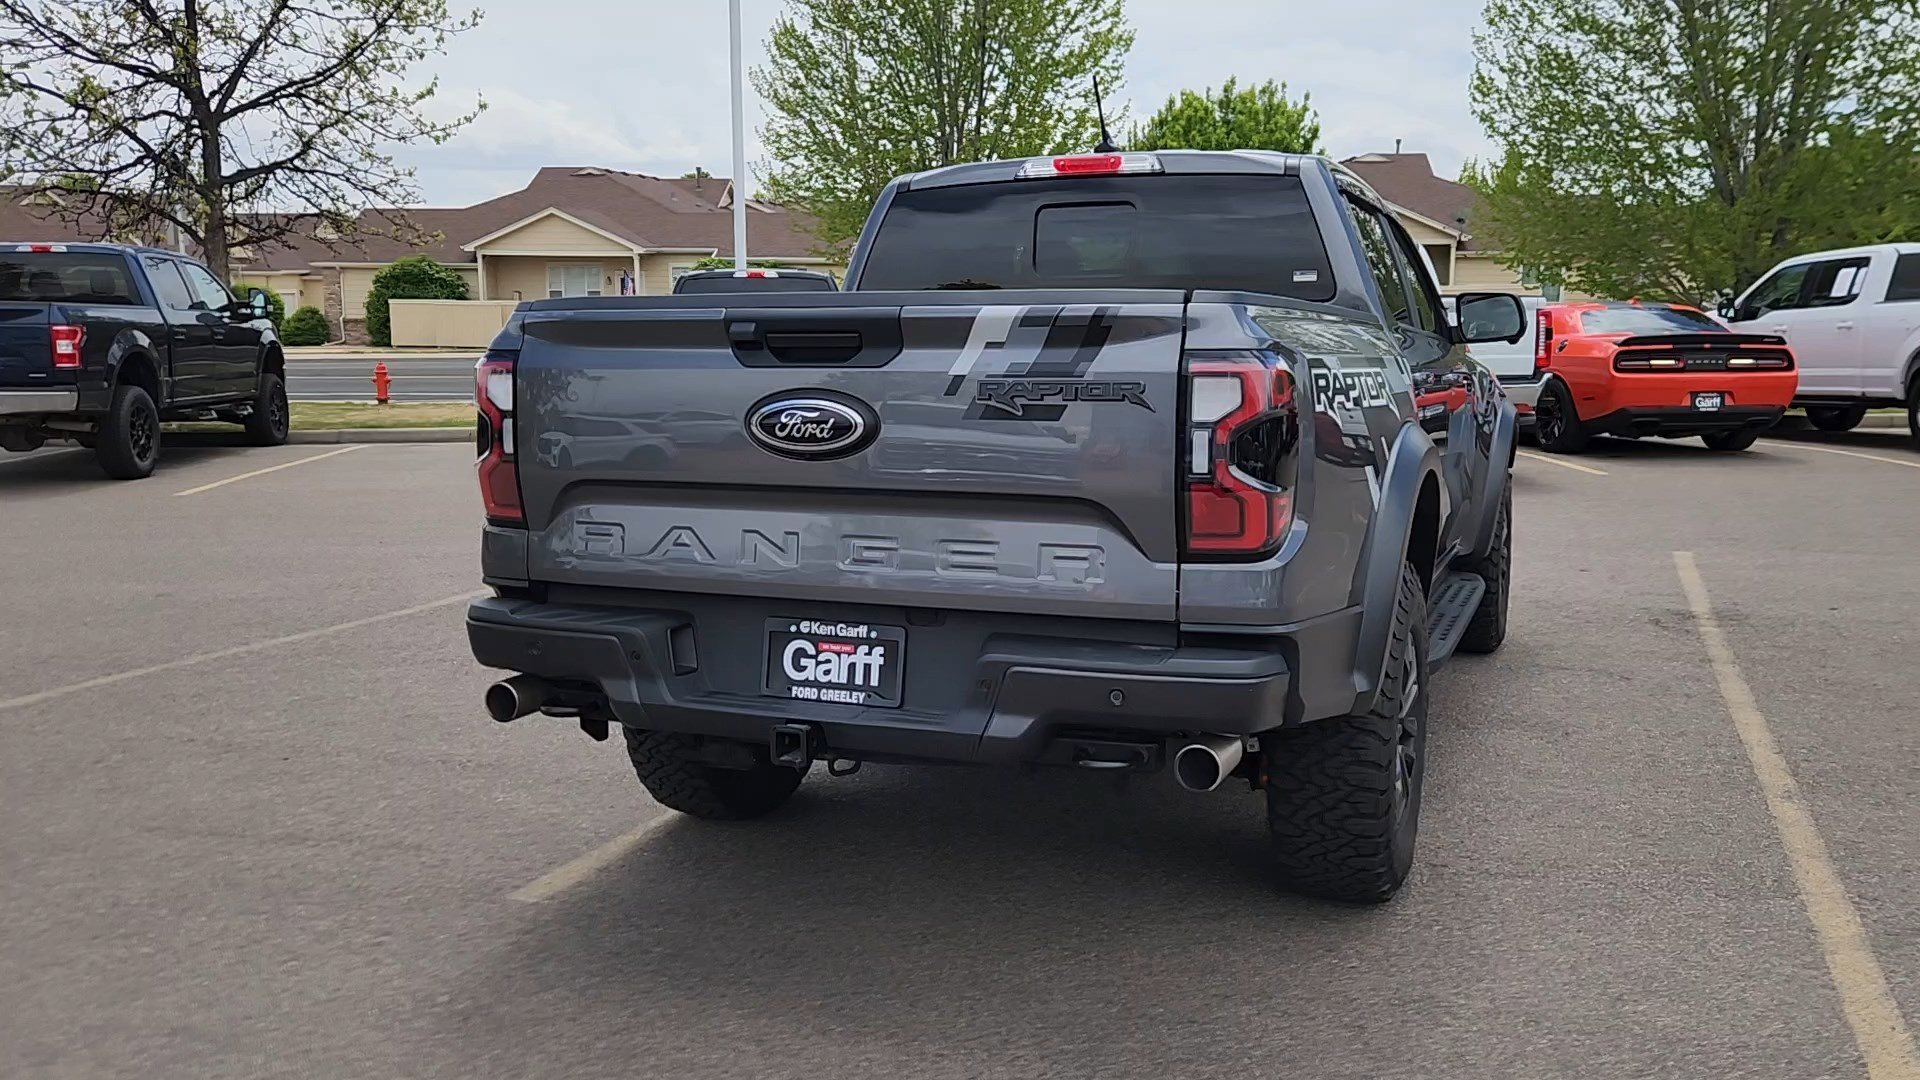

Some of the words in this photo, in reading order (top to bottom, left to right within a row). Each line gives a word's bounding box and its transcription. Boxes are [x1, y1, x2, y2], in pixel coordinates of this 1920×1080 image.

[976, 378, 1156, 414] RAPTOR
[1311, 367, 1398, 428] RAPTOR
[1695, 396, 1721, 408] Garff
[774, 408, 835, 440] Ford
[574, 519, 1106, 585] RANGER
[810, 620, 835, 636] Ken
[836, 623, 868, 639] Garff
[783, 638, 885, 687] Garff
[791, 686, 818, 700] FORD
[820, 688, 866, 704] GREELEY
